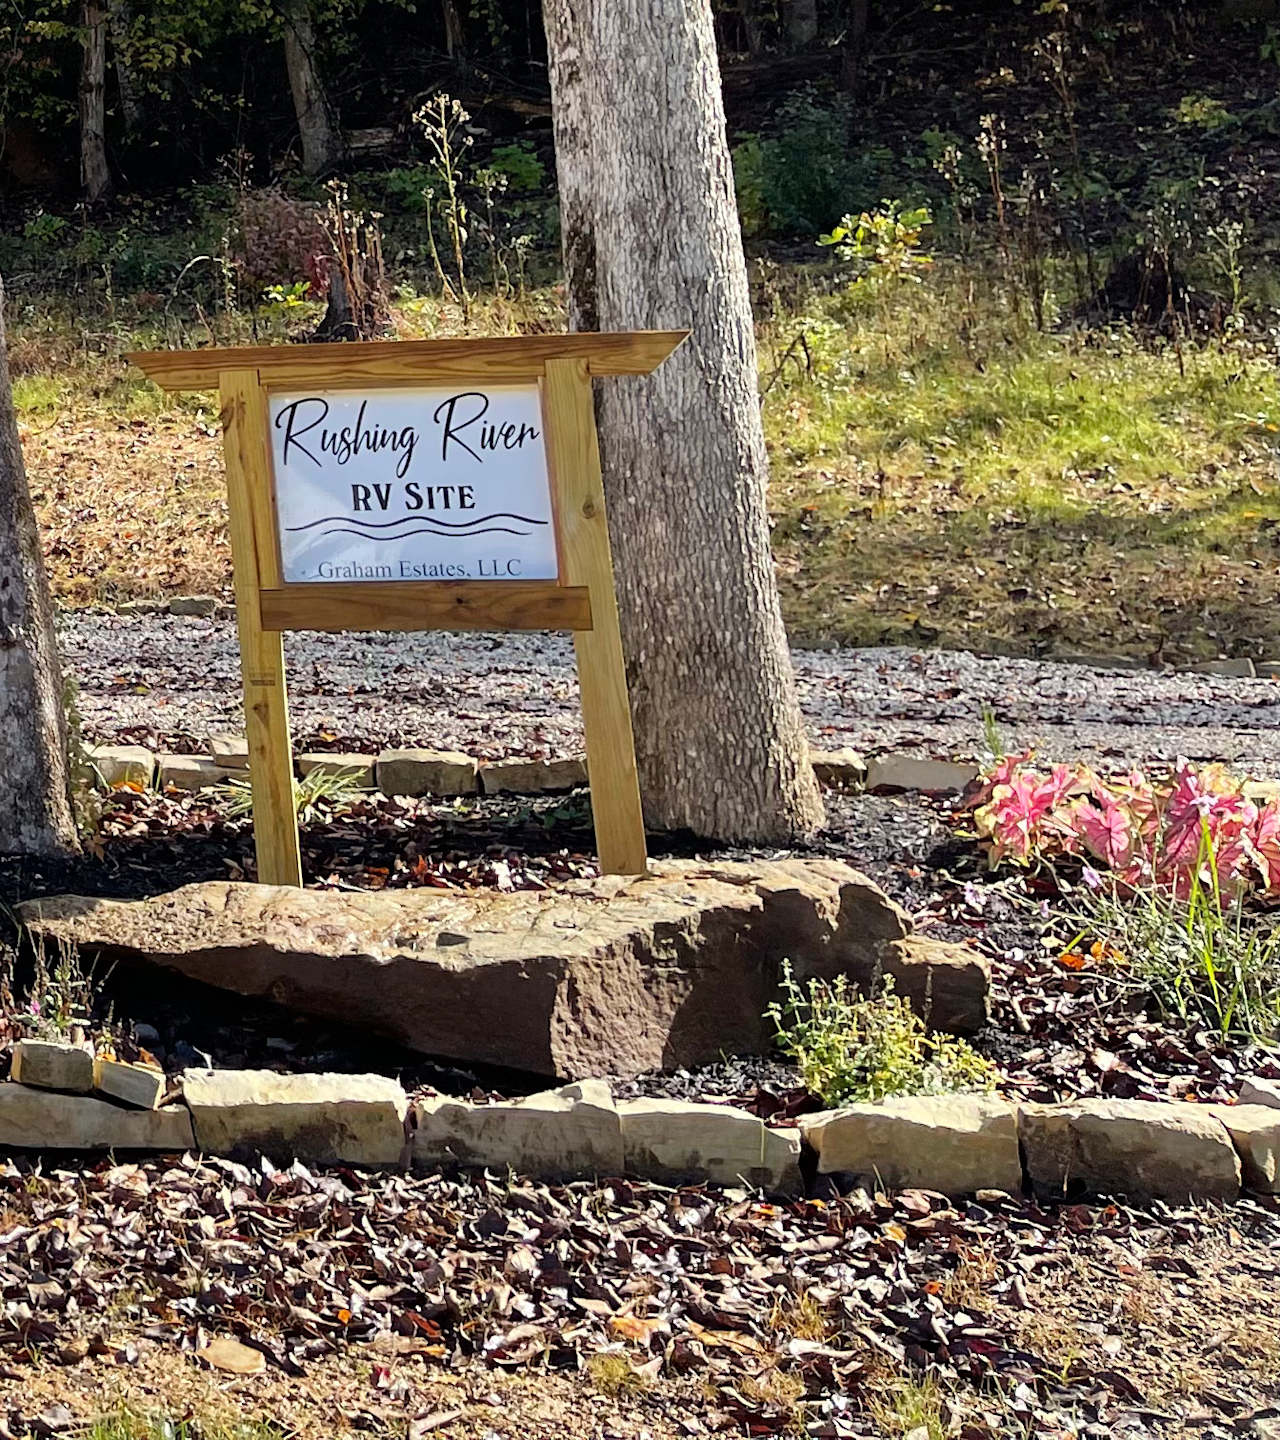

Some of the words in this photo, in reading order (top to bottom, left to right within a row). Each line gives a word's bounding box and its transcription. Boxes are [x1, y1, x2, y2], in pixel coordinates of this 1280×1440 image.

[275, 397, 419, 479] Rushing
[433, 392, 540, 462] River
[351, 483, 392, 511] RV
[318, 561, 392, 579] Graham
[479, 558, 522, 577] LLC
